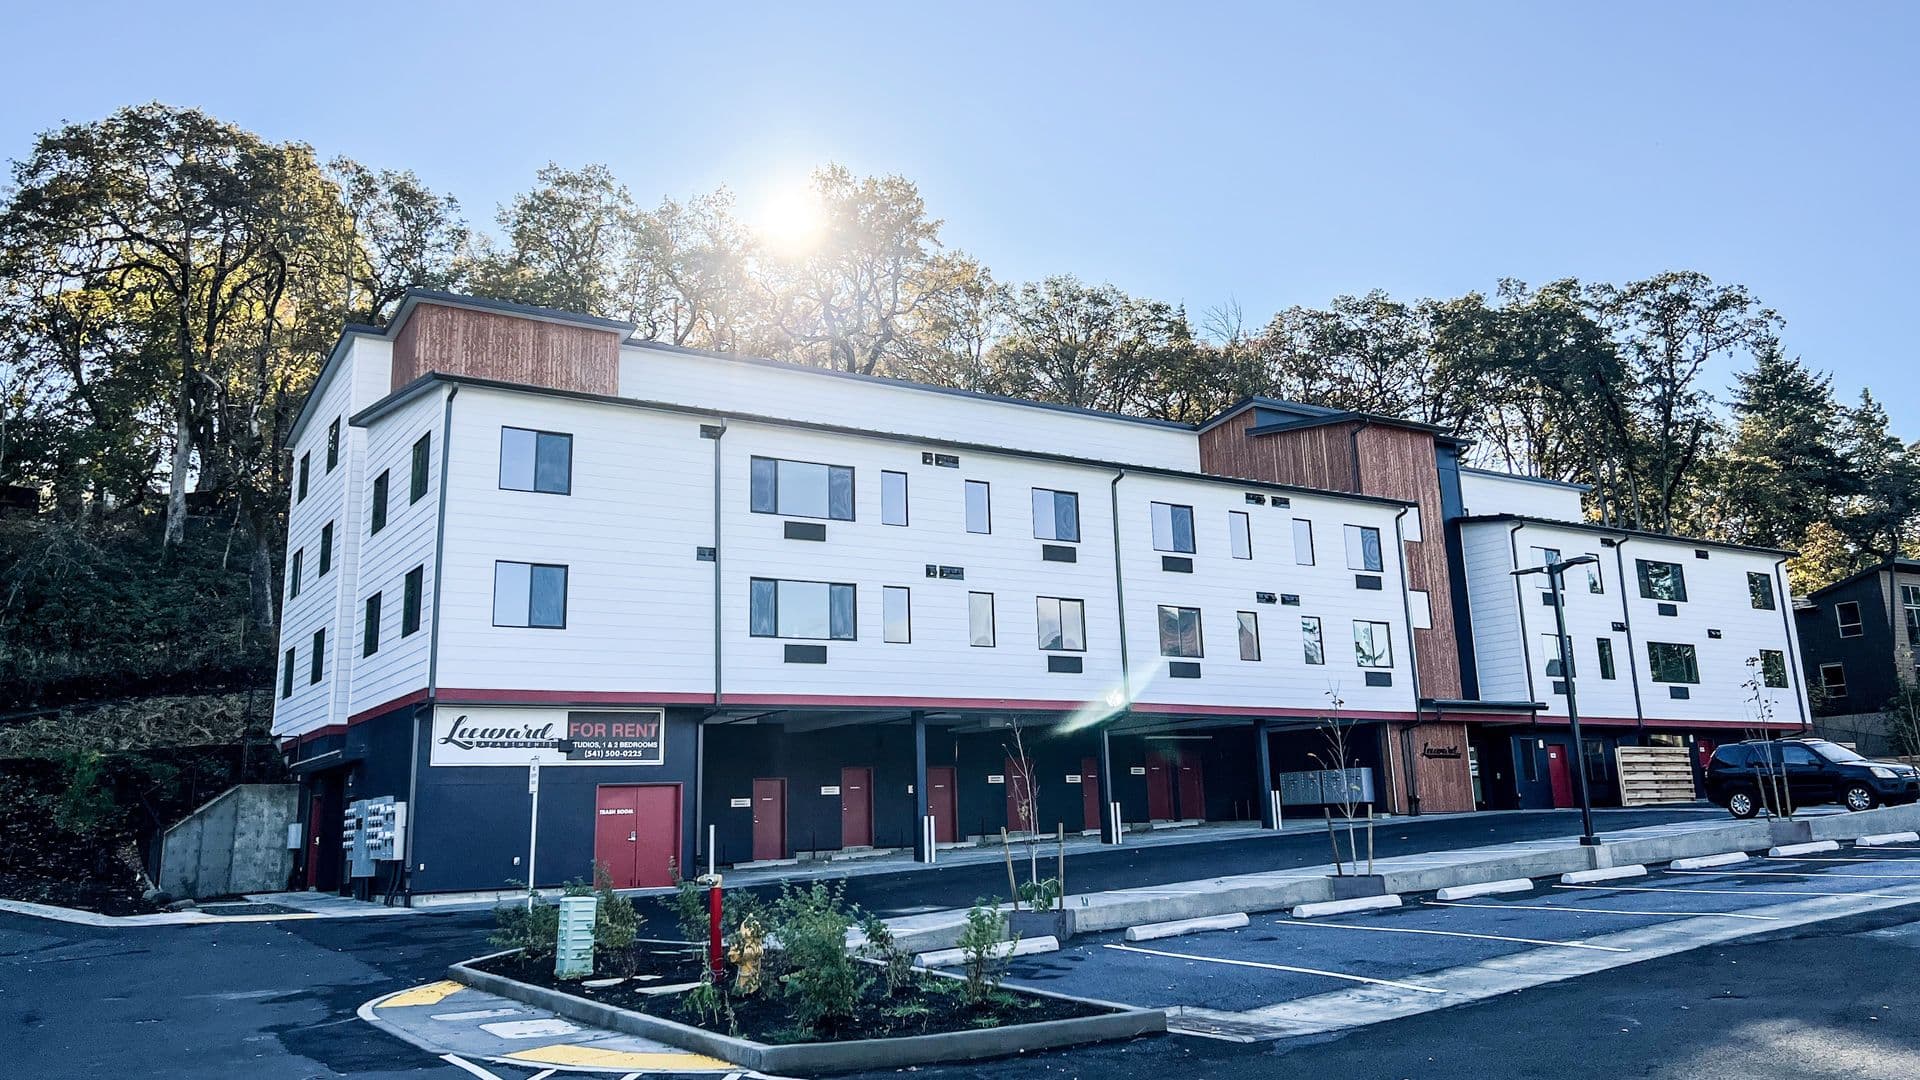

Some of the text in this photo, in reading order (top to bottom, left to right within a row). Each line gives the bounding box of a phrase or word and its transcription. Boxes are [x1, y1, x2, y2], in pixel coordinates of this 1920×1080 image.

[438, 715, 555, 750] Leeward
[569, 723, 658, 737] FOR RENT
[572, 741, 601, 749] TUDIOS,
[619, 741, 658, 749] BEDROOMS
[584, 749, 604, 758] (541)
